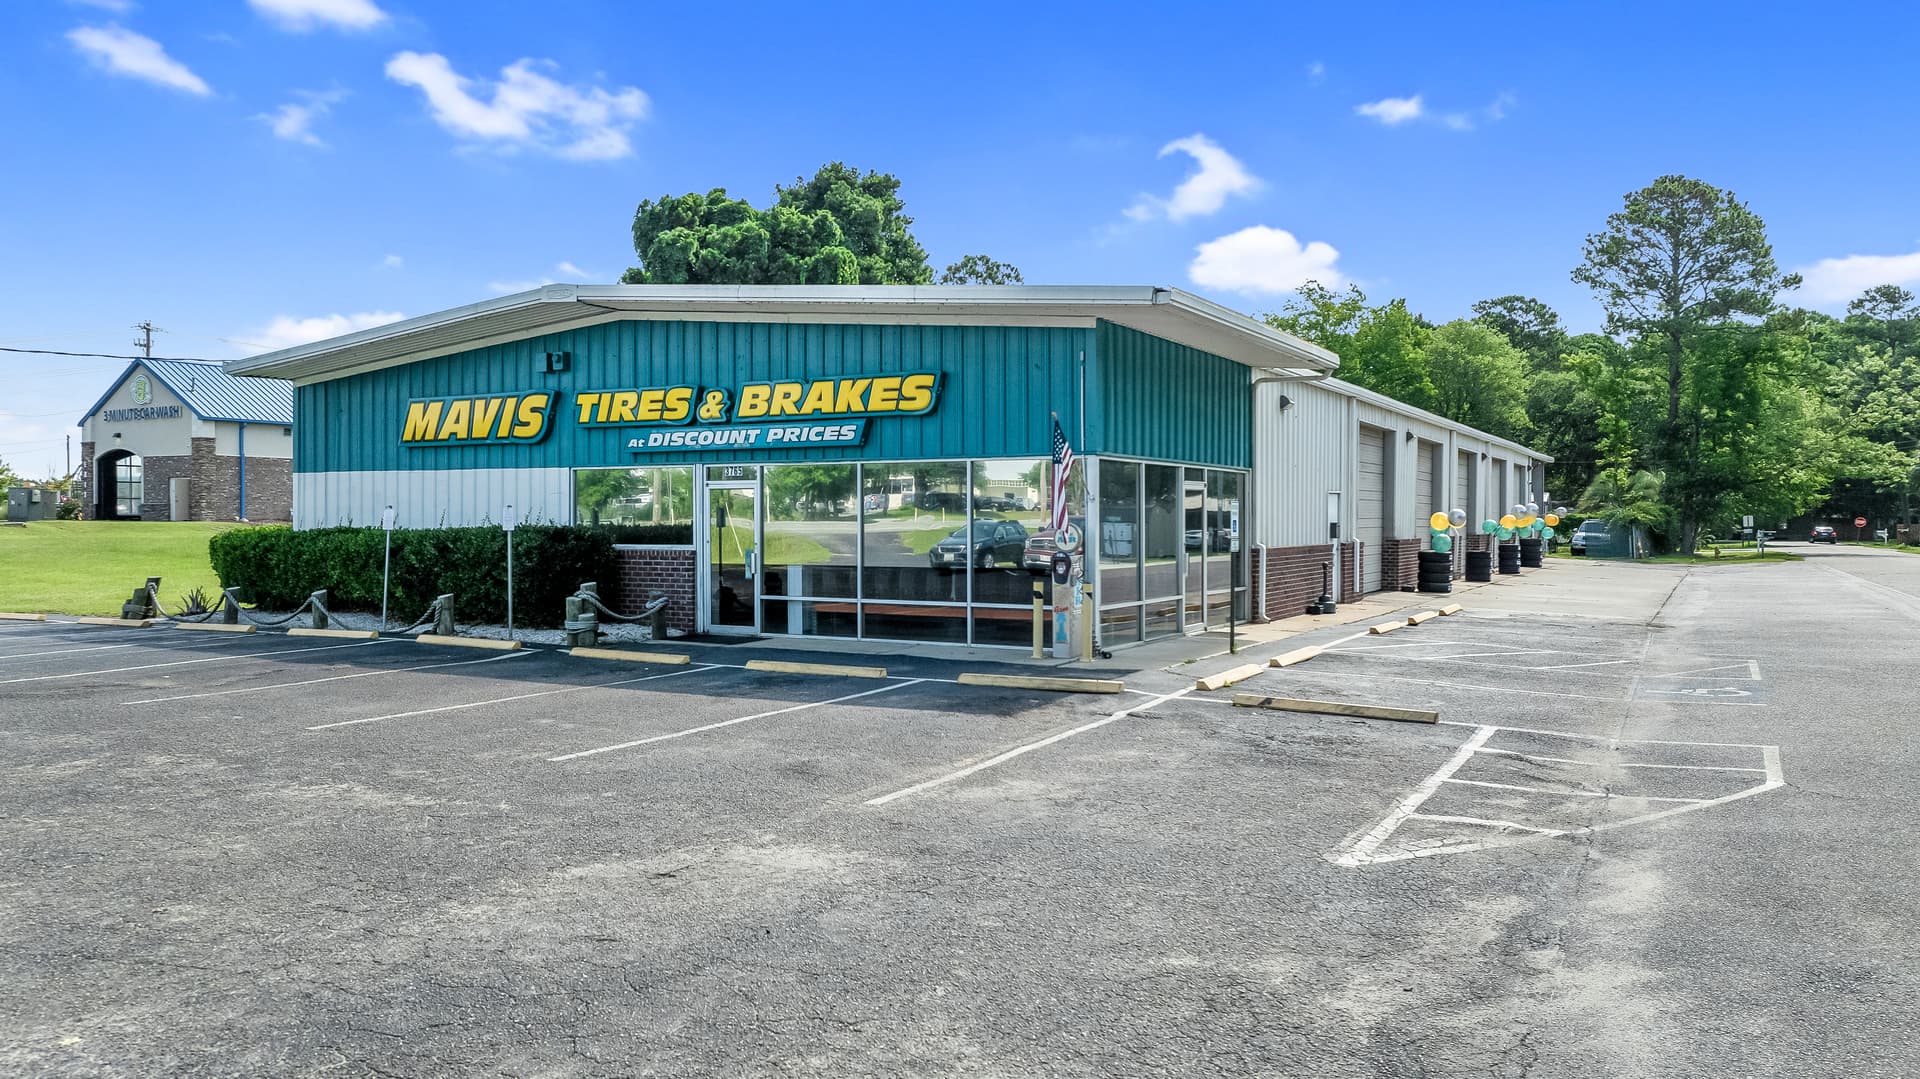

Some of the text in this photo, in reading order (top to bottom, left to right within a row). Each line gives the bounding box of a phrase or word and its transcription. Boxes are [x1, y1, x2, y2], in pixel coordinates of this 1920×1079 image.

[402, 394, 548, 441] MAVIS
[576, 374, 935, 423] TIRES & BRAKES
[648, 430, 761, 447] DISCOUNT
[766, 425, 857, 443] PRICES
